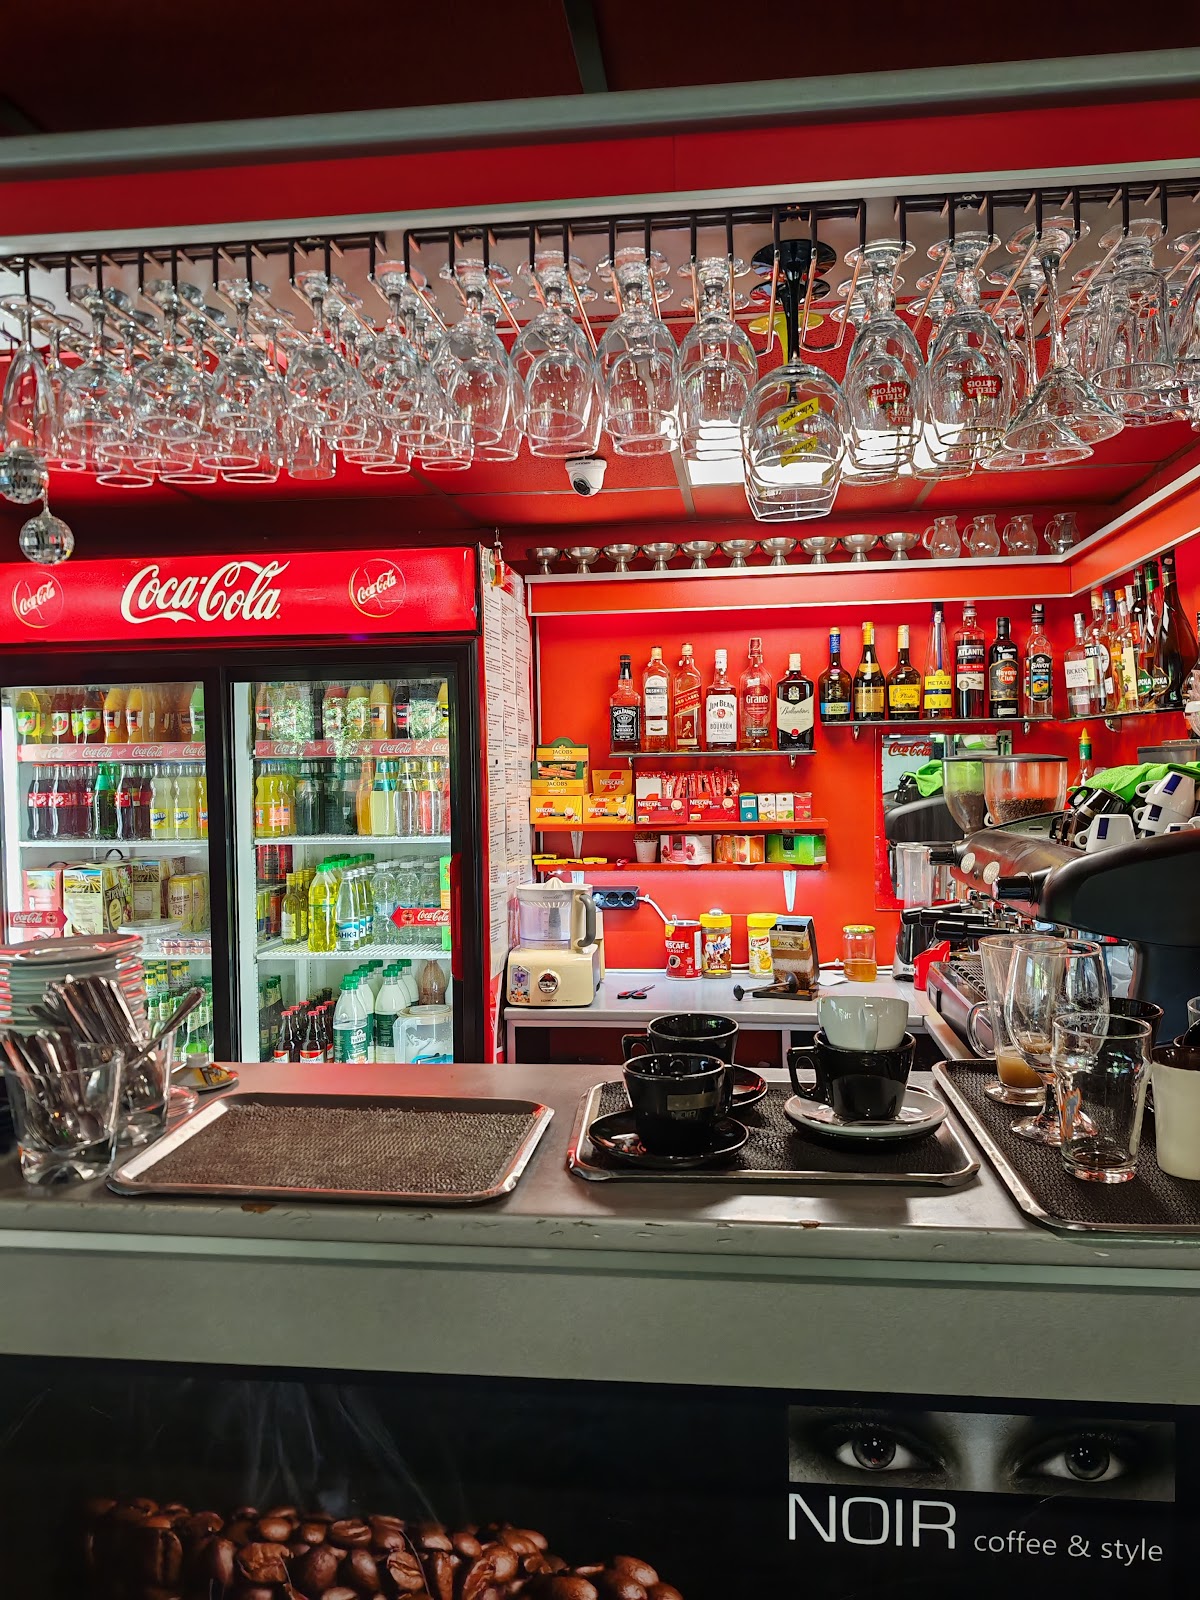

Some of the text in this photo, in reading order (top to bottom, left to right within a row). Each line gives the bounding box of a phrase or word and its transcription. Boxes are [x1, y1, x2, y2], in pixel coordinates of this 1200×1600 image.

[967, 379, 998, 388] ARTOIS
[871, 384, 907, 397] ARTOIS
[967, 386, 997, 395] STELLA
[872, 391, 904, 403] STELLA
[120, 560, 290, 624] Coca-Cola
[1031, 662, 1050, 670] SAVOY
[995, 669, 1017, 677] Havana
[788, 1493, 1163, 1566] NOIR coffee & style
